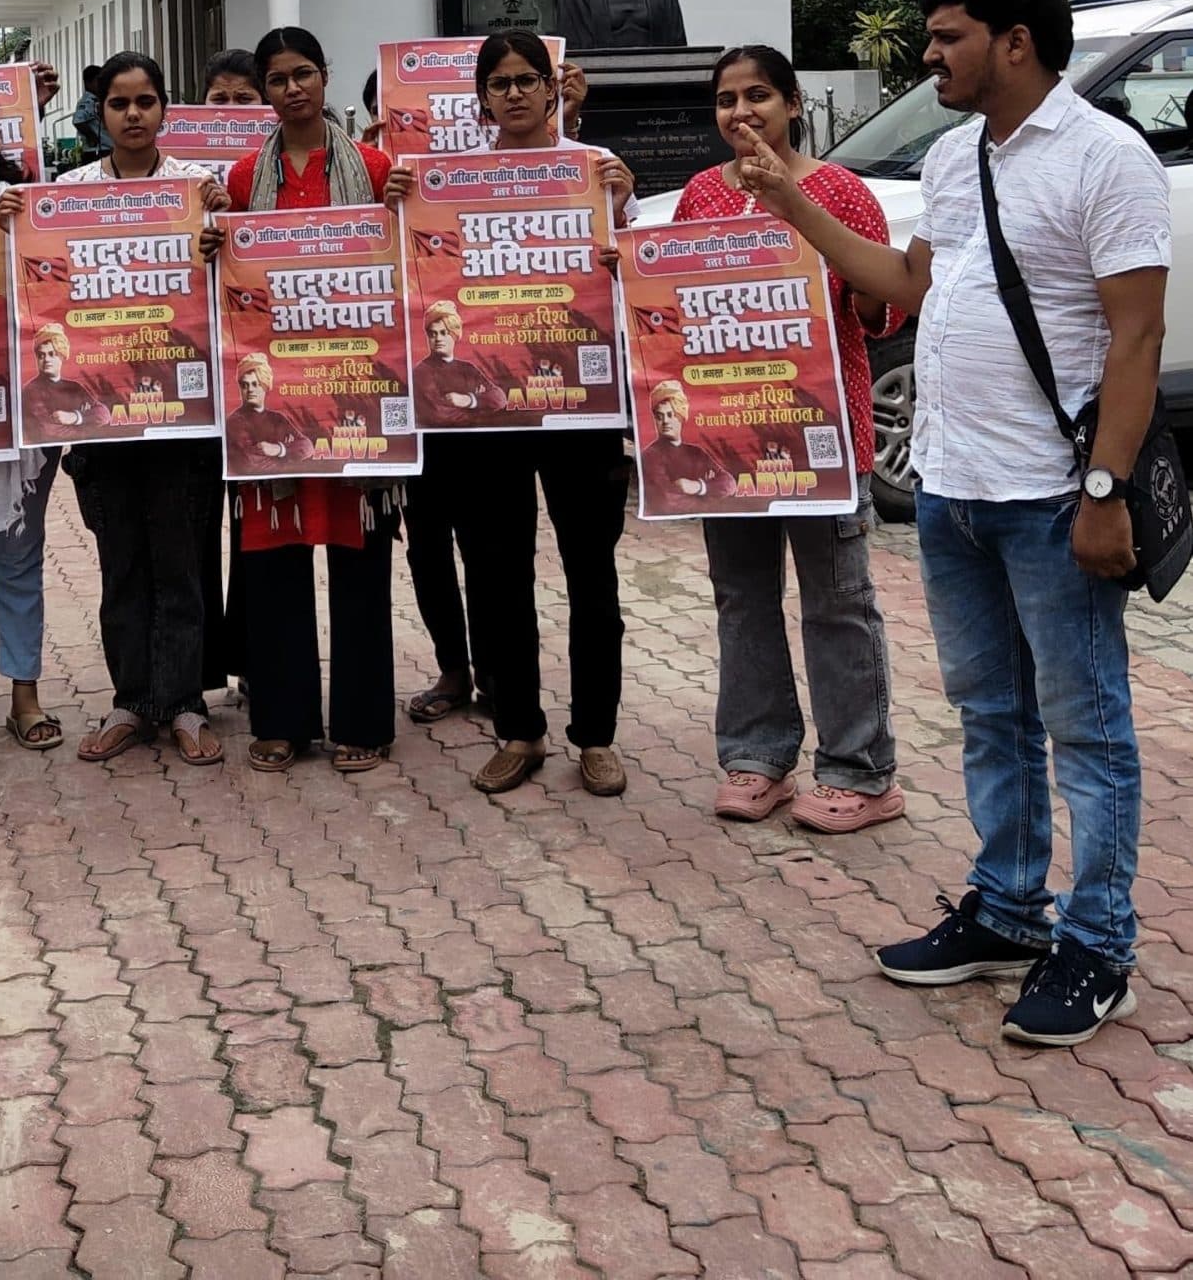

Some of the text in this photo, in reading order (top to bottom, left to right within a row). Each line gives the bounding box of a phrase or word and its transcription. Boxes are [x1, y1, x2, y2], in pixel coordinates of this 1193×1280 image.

[422, 52, 449, 66] अखिल
[201, 120, 226, 133] भारतीय
[259, 120, 279, 133] परि
[448, 166, 580, 184] अखिल भारतीय विद्यार्थी परिषद्
[59, 193, 181, 211] अखिल भारतीय विद्यार्थी परिषद्
[257, 223, 382, 242] अखिल भारतीय विद्यार्थी परिषद्
[458, 208, 593, 243] सदस्यता
[67, 233, 192, 268] सदस्यता
[661, 231, 790, 256] अखिल भारतीय विद्यार्थी परिषद्
[462, 241, 593, 277] अभियान
[70, 266, 192, 301] अभियान
[267, 264, 395, 300] सदस्यता
[466, 290, 476, 301] 01
[509, 289, 518, 299] 31
[545, 287, 563, 297] 2025
[675, 277, 811, 319] सदस्यता
[74, 313, 83, 323] 01
[114, 310, 123, 321] 31
[148, 308, 164, 318] 2025
[271, 297, 395, 332] अभियान
[536, 305, 568, 325] विश्व
[518, 329, 542, 344] छात्र
[682, 316, 813, 355] अभियान
[276, 344, 285, 354] 01
[316, 343, 325, 353] 31
[351, 341, 368, 350] 2025
[342, 358, 373, 377] विश्व
[690, 369, 700, 380] 01
[731, 366, 741, 378] 31
[767, 364, 786, 375] 2025
[325, 381, 347, 395] छात्र
[760, 384, 793, 405] विश्व
[506, 387, 587, 411] ABVP
[110, 402, 184, 426] ABVP
[743, 409, 768, 425] छात्र
[313, 438, 388, 459] ABVP
[736, 472, 818, 497] ABVP
